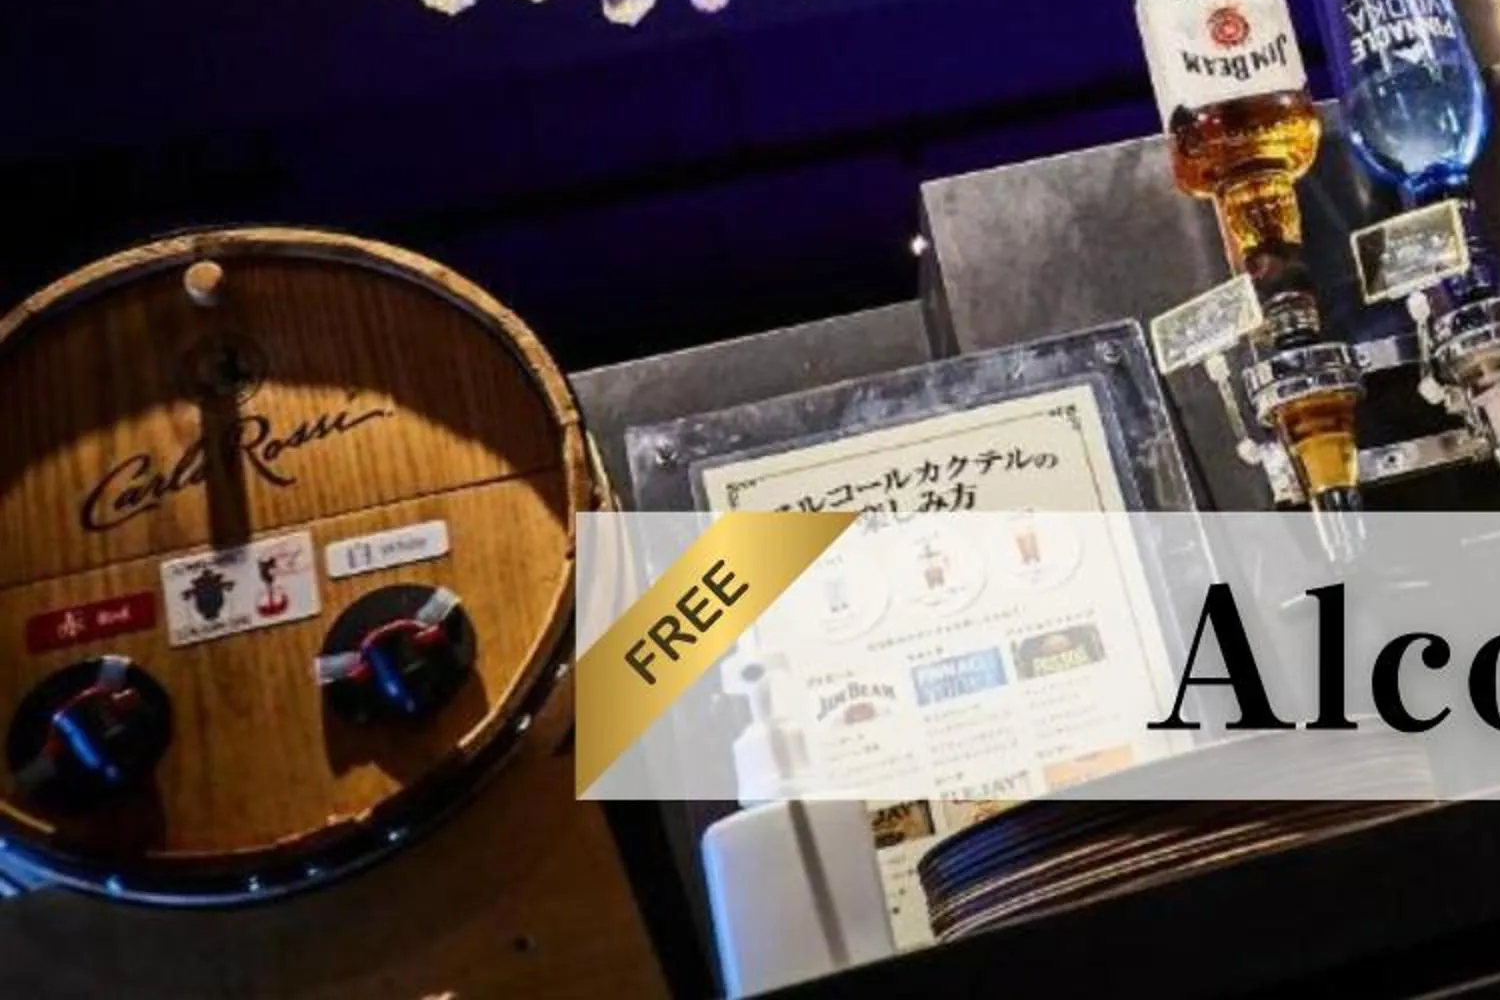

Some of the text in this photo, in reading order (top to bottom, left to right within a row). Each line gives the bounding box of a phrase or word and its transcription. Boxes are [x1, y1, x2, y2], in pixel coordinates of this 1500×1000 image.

[1181, 32, 1288, 82] JIM BEAM
[80, 438, 214, 532] Carl
[774, 446, 1060, 513] ルコールカクテルの
